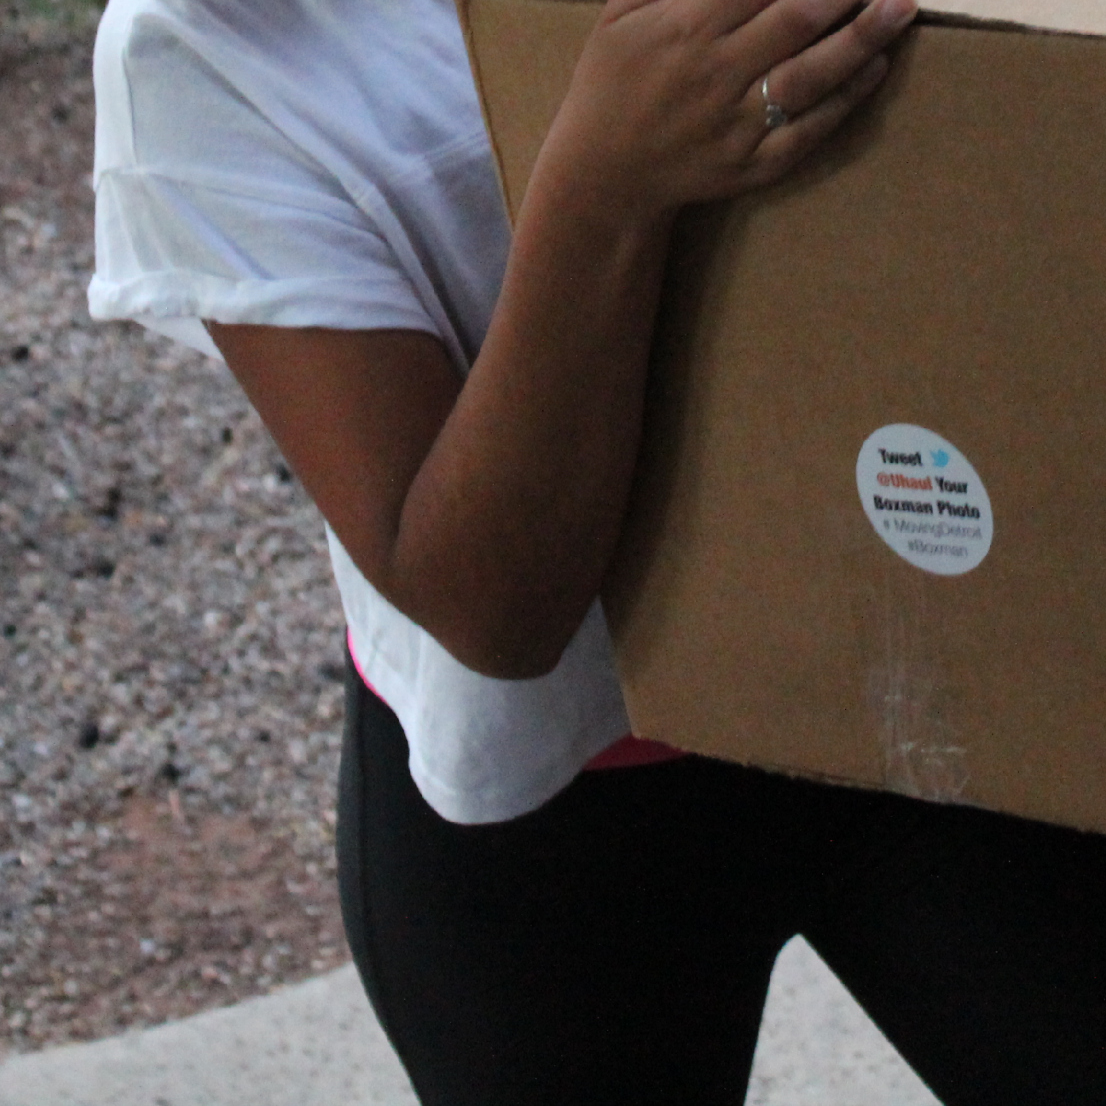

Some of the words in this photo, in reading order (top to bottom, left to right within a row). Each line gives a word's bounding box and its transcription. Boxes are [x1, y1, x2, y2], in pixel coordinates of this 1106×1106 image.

[878, 448, 923, 467] Tweet
[876, 472, 933, 491] @Uhaul
[935, 476, 968, 494] Your
[873, 494, 934, 515] Boxman
[937, 500, 981, 520] Photo
